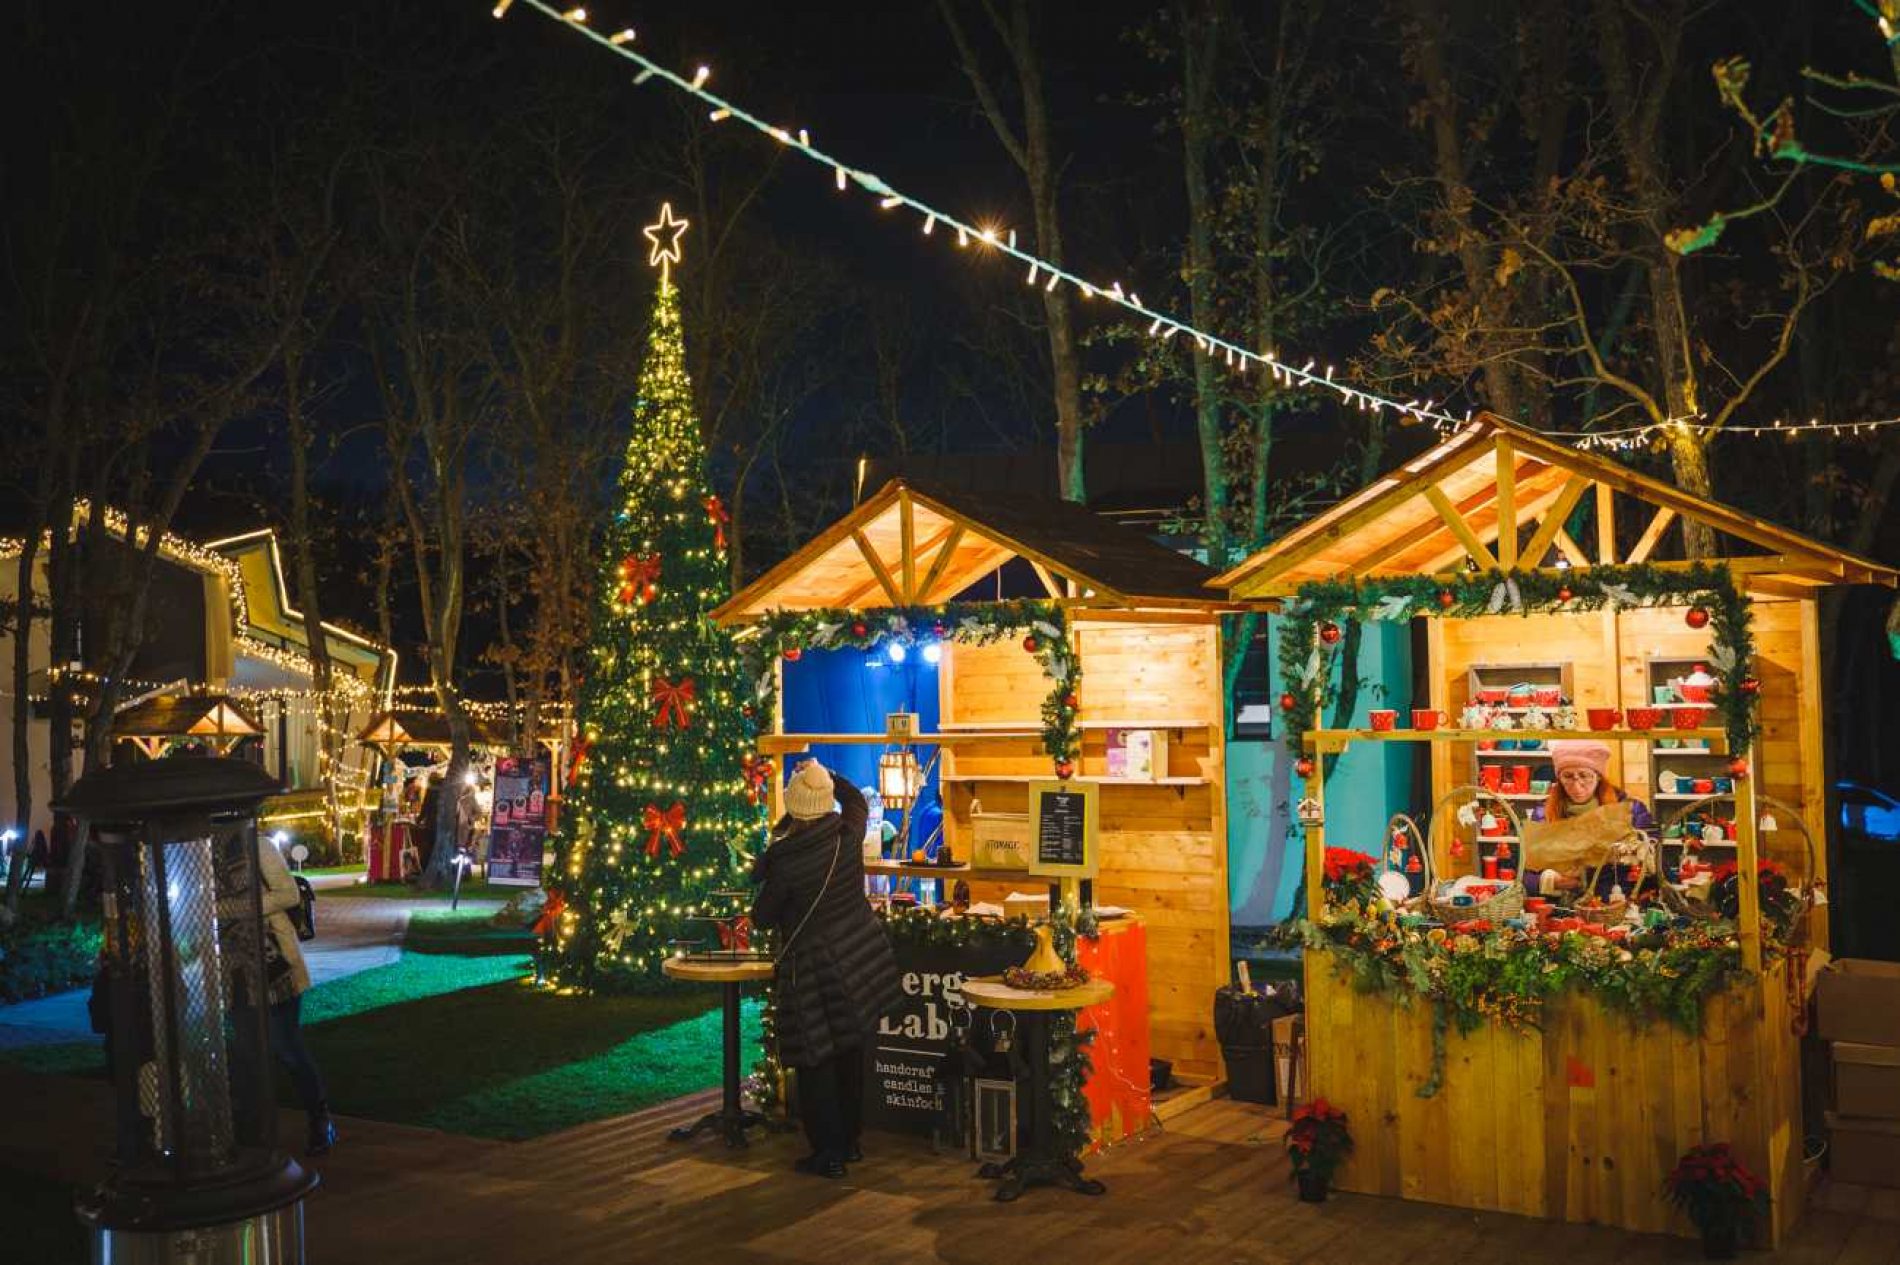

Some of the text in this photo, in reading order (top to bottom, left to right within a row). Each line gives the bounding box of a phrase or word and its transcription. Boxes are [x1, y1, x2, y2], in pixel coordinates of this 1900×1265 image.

[902, 971, 977, 1010] erg
[876, 1003, 948, 1041] Lab
[875, 1060, 935, 1079] handcraf
